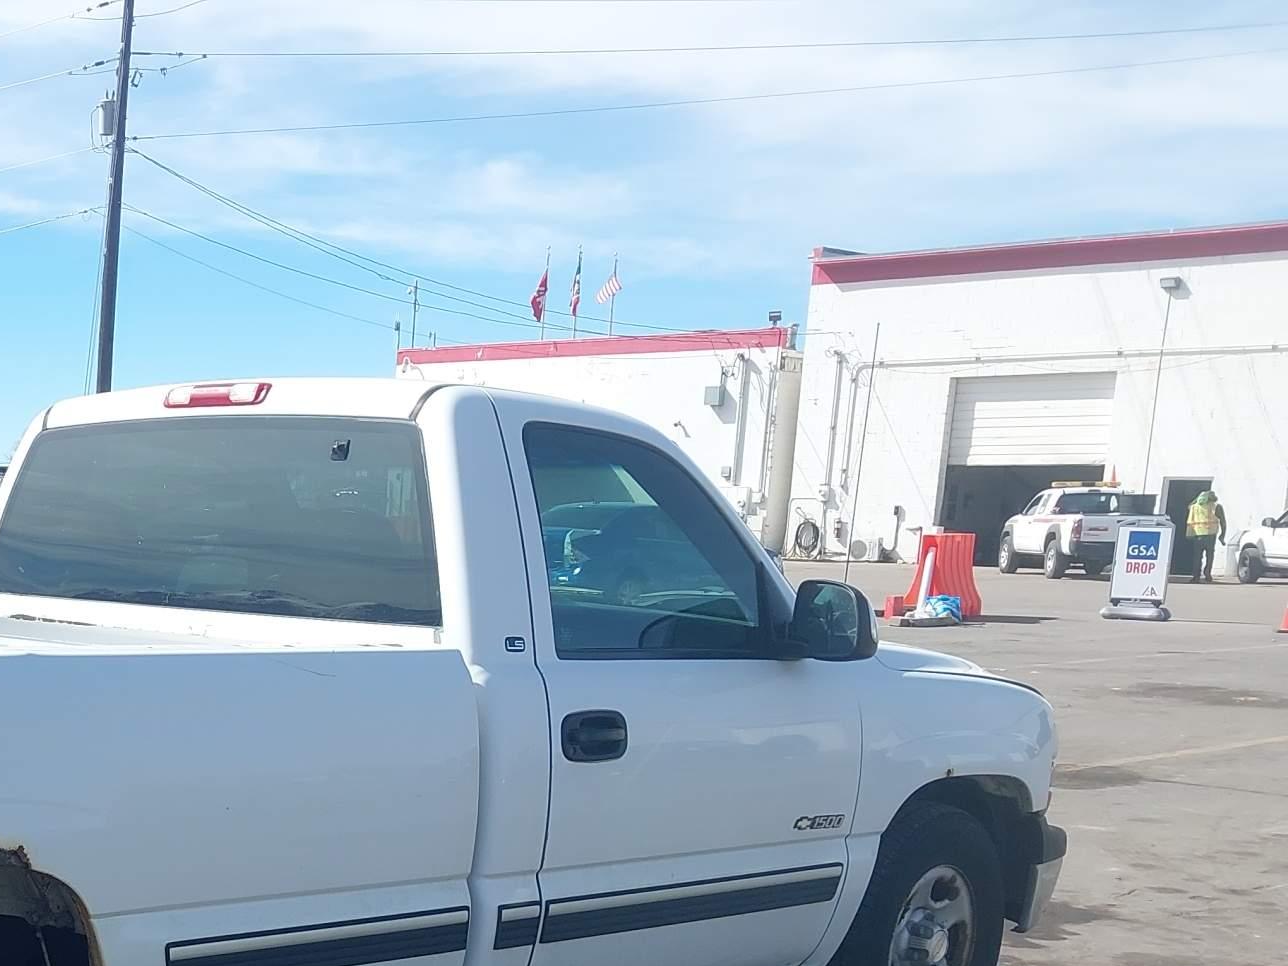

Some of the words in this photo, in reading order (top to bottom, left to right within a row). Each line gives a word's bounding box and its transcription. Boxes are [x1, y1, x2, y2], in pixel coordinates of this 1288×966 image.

[1128, 544, 1157, 557] GSA
[1125, 561, 1156, 575] DROP
[814, 815, 844, 829] 1500
